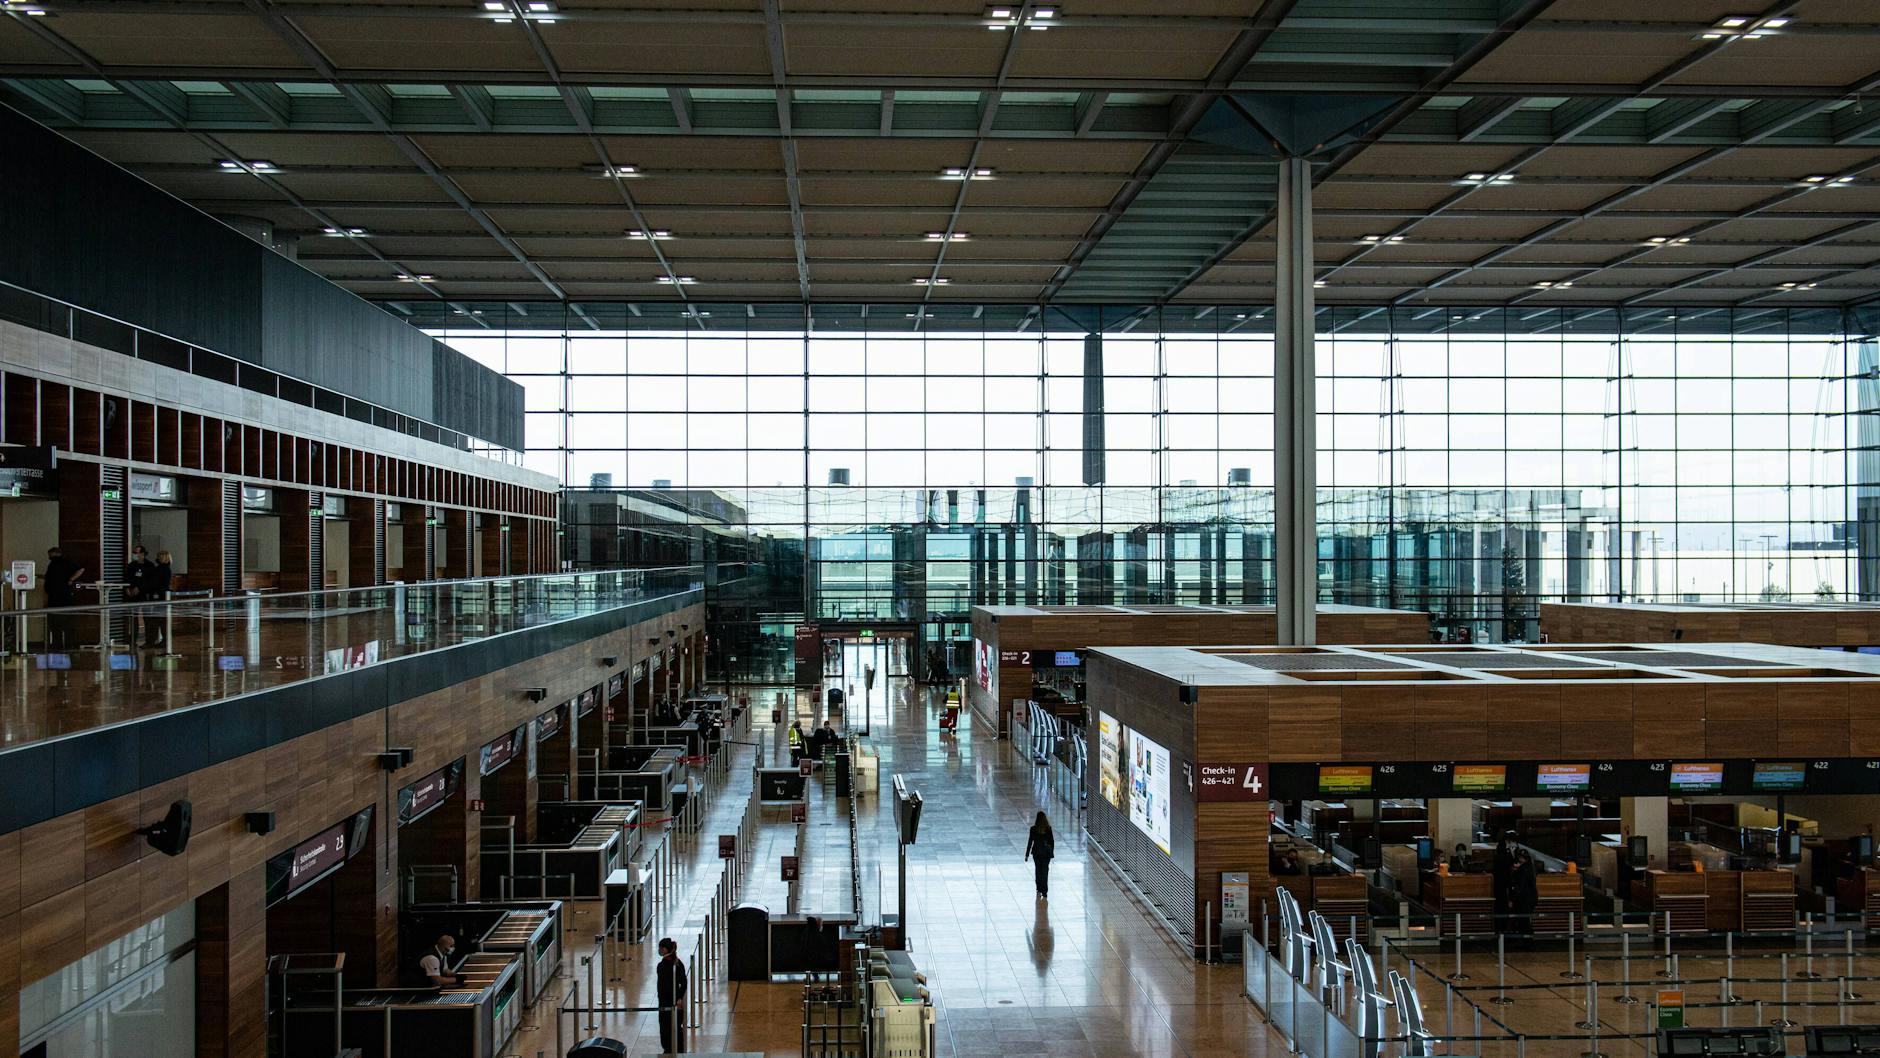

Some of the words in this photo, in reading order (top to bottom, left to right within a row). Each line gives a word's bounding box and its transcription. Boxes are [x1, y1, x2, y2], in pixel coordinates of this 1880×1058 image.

[1021, 651, 1030, 665] 2
[1380, 765, 1396, 774] 426
[1432, 765, 1448, 773] 425
[1598, 763, 1614, 772] 424
[1650, 763, 1666, 772] 423
[1814, 761, 1829, 769] 422
[1866, 761, 1880, 769] 421
[1202, 766, 1236, 775] Check-in
[1202, 777, 1235, 785] 426–421
[1243, 766, 1262, 794] 4
